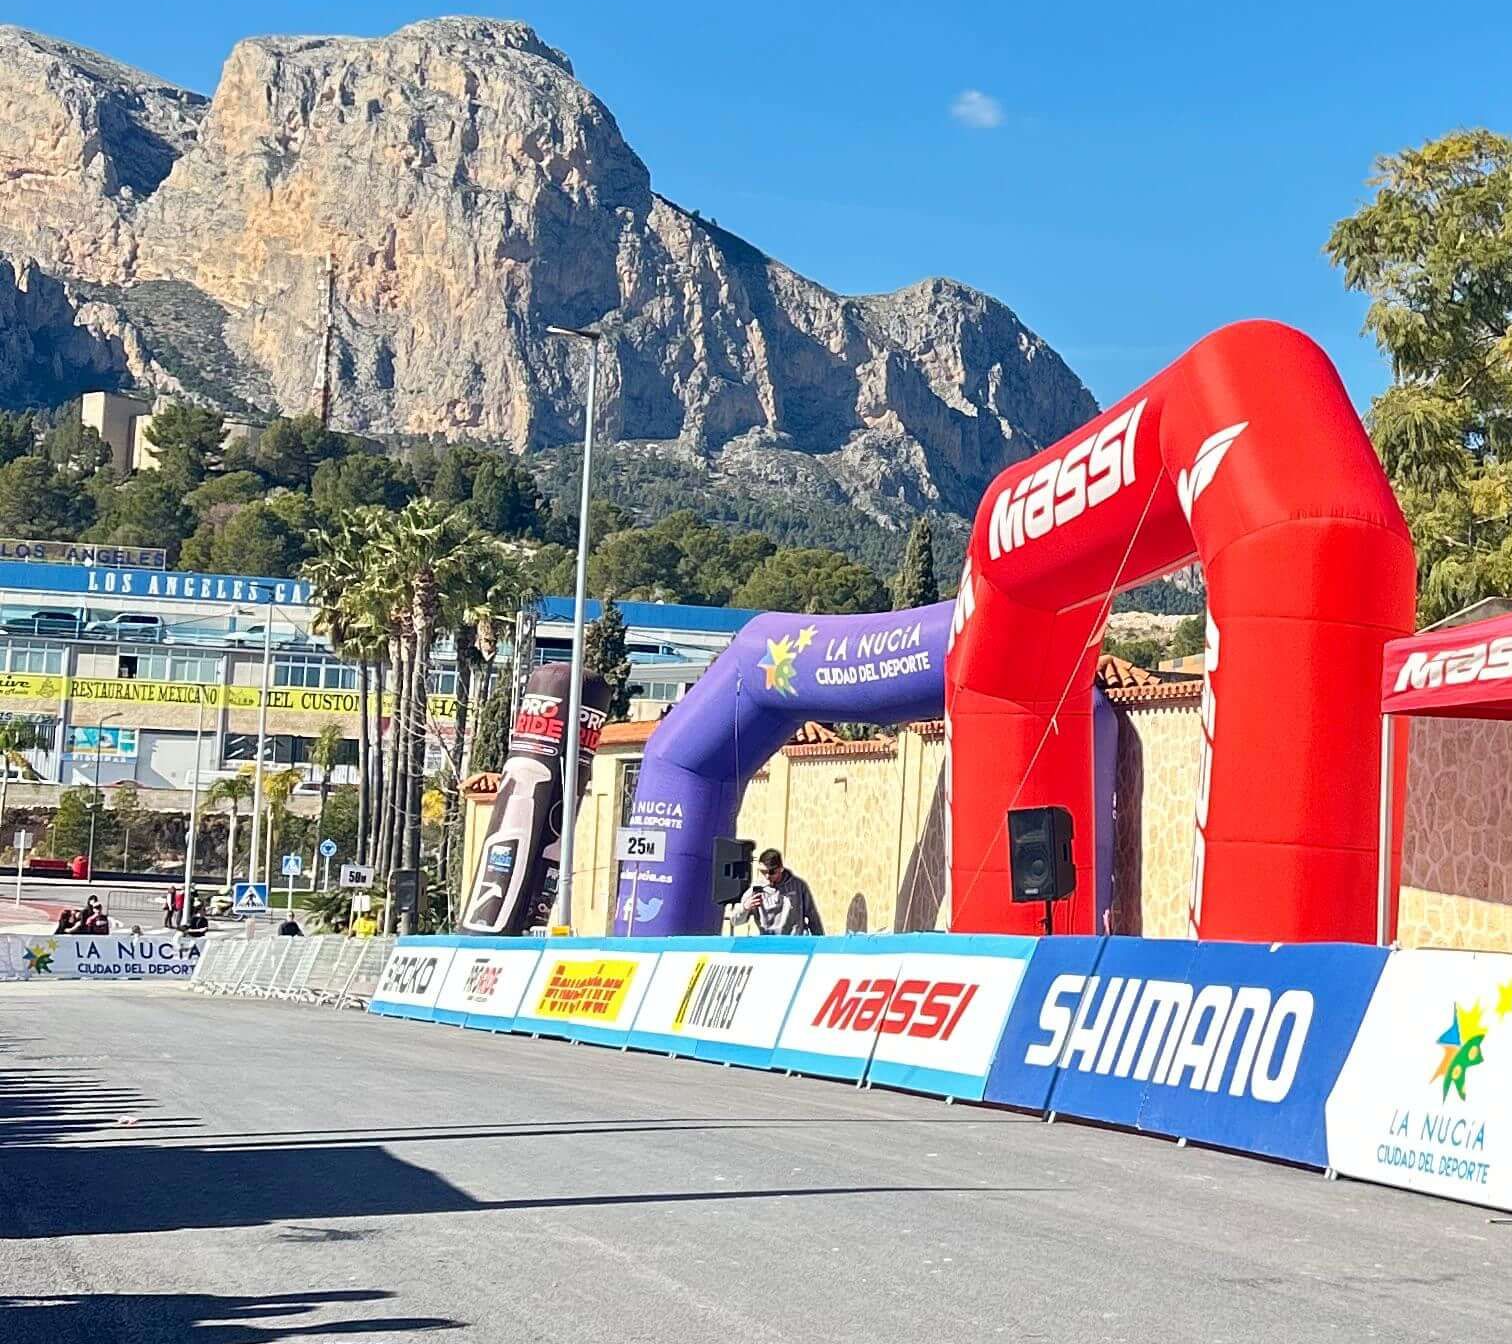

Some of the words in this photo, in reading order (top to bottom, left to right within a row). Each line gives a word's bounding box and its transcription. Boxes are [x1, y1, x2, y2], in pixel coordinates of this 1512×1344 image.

[0, 542, 46, 558] LOS
[67, 547, 166, 565] ANGELES
[87, 571, 132, 594] LOS
[149, 575, 258, 602] ANGELES
[825, 636, 848, 662] LA
[815, 666, 858, 686] CIUDAD
[859, 663, 879, 683] DEL
[880, 651, 931, 678] DEPORTE
[71, 680, 156, 700] RESTAURANTE
[157, 686, 218, 705] MEXICANO
[520, 698, 559, 719] PRO
[516, 715, 565, 739] RIDE
[75, 941, 101, 960] LA
[78, 963, 122, 975] CIUDAD
[125, 963, 146, 974] DEL
[1025, 974, 1315, 1104] SHIMANO
[1389, 1109, 1410, 1137] LA
[1377, 1144, 1416, 1169] CIUDAD
[1418, 1151, 1435, 1174] DEL
[1438, 1155, 1491, 1184] DEPORTE
